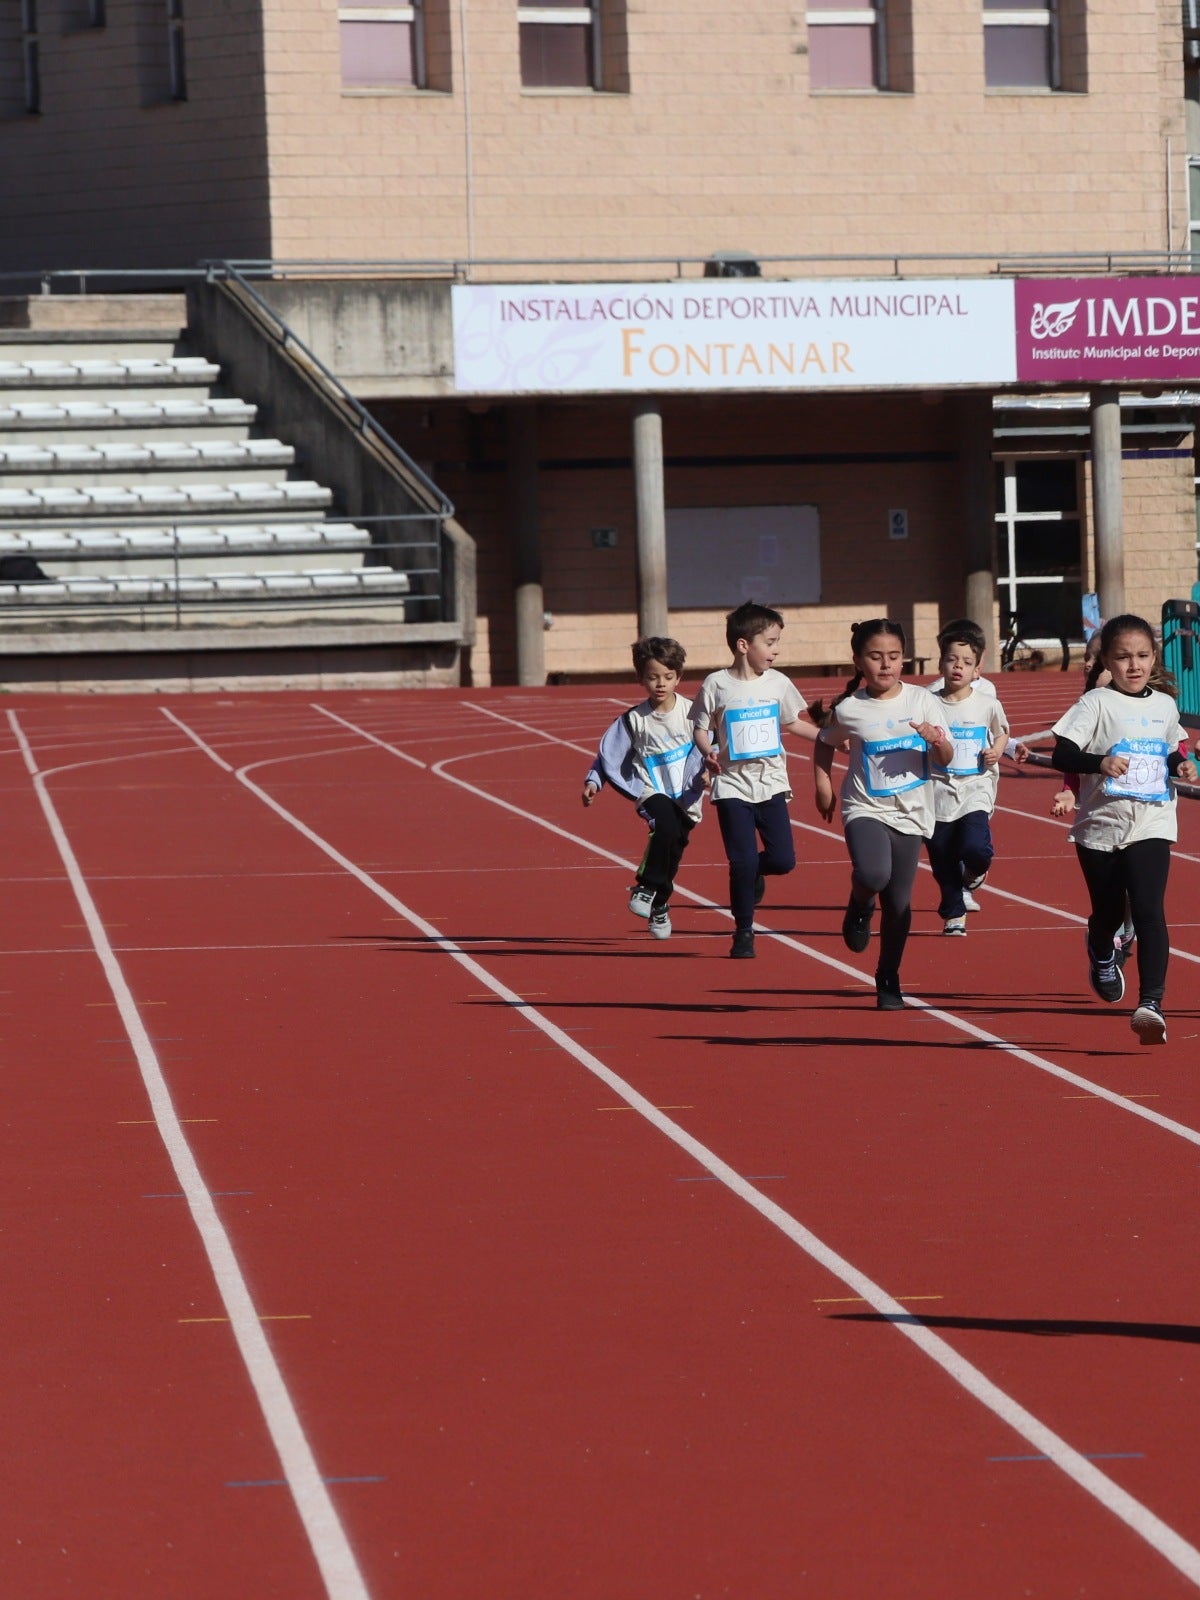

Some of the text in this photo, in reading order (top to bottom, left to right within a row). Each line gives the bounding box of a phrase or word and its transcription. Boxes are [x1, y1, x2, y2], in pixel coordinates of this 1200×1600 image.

[500, 293, 968, 321] INSTALACIÓN DEPORTIVA MUNICIPAL
[1032, 347, 1081, 360] Instituto
[1083, 346, 1141, 361] Municipal
[1144, 345, 1159, 357] de
[739, 709, 762, 719] unicef
[736, 723, 769, 747] 105
[876, 740, 902, 752] unicef
